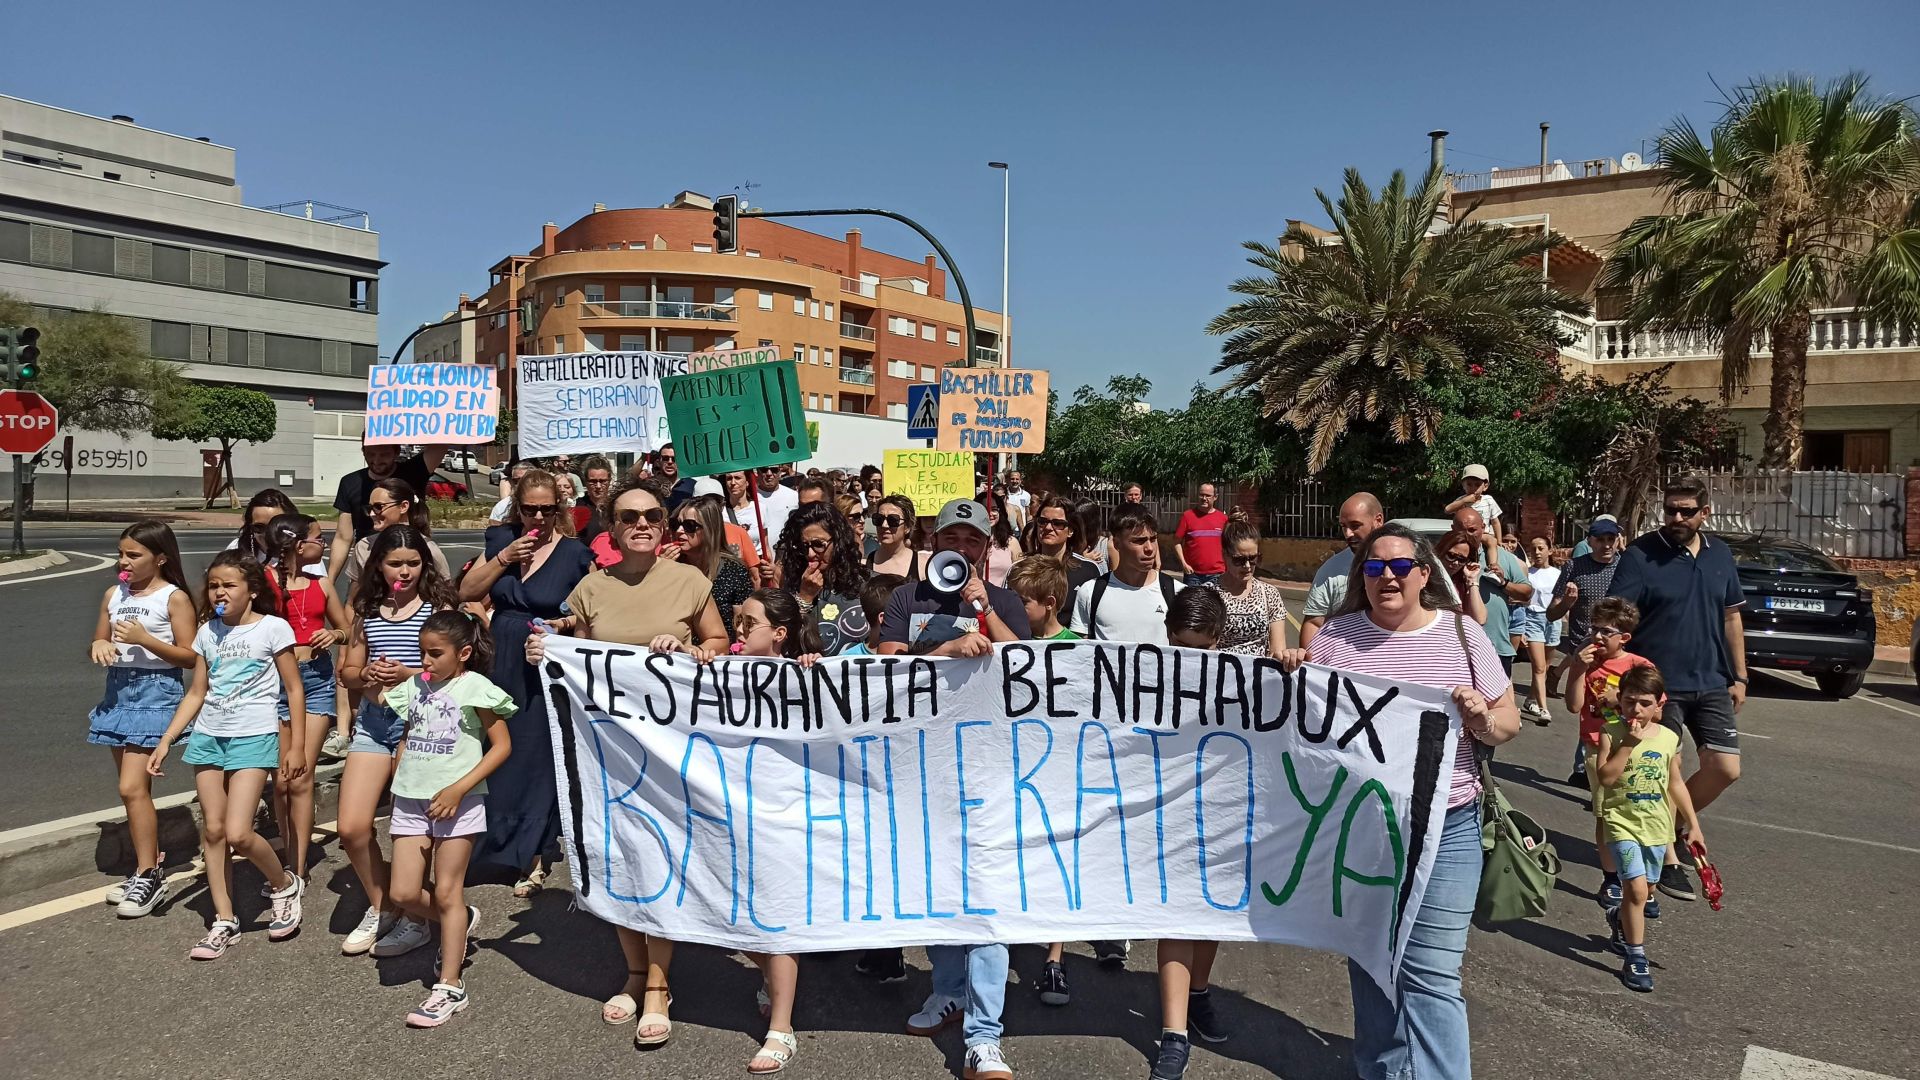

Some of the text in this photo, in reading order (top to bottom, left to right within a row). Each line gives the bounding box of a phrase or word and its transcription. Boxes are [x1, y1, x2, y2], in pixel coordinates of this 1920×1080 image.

[523, 355, 626, 383] BACHILLERATO
[632, 355, 648, 379] EN
[669, 371, 751, 401] APRENDER
[368, 389, 487, 411] CALIDAD EN
[556, 384, 658, 412] SEMBRANDO
[367, 412, 441, 438] NUSTRO
[696, 404, 721, 426] ES
[546, 415, 648, 441] COSECHANDO
[960, 428, 1024, 449] FUTURO
[682, 421, 760, 466] CRECER
[896, 452, 972, 469] ESTUDIAR
[917, 470, 938, 482] ES
[898, 482, 958, 496] NUESTRO
[955, 503, 973, 519] S
[117, 606, 150, 617] BROOKLYN
[1773, 598, 1822, 610] 7612 MYS
[690, 657, 938, 732] AURANTIA
[1001, 642, 1400, 764] BENAHADUX
[589, 718, 1255, 932] BACHILLERATO
[1261, 751, 1405, 952] YA
